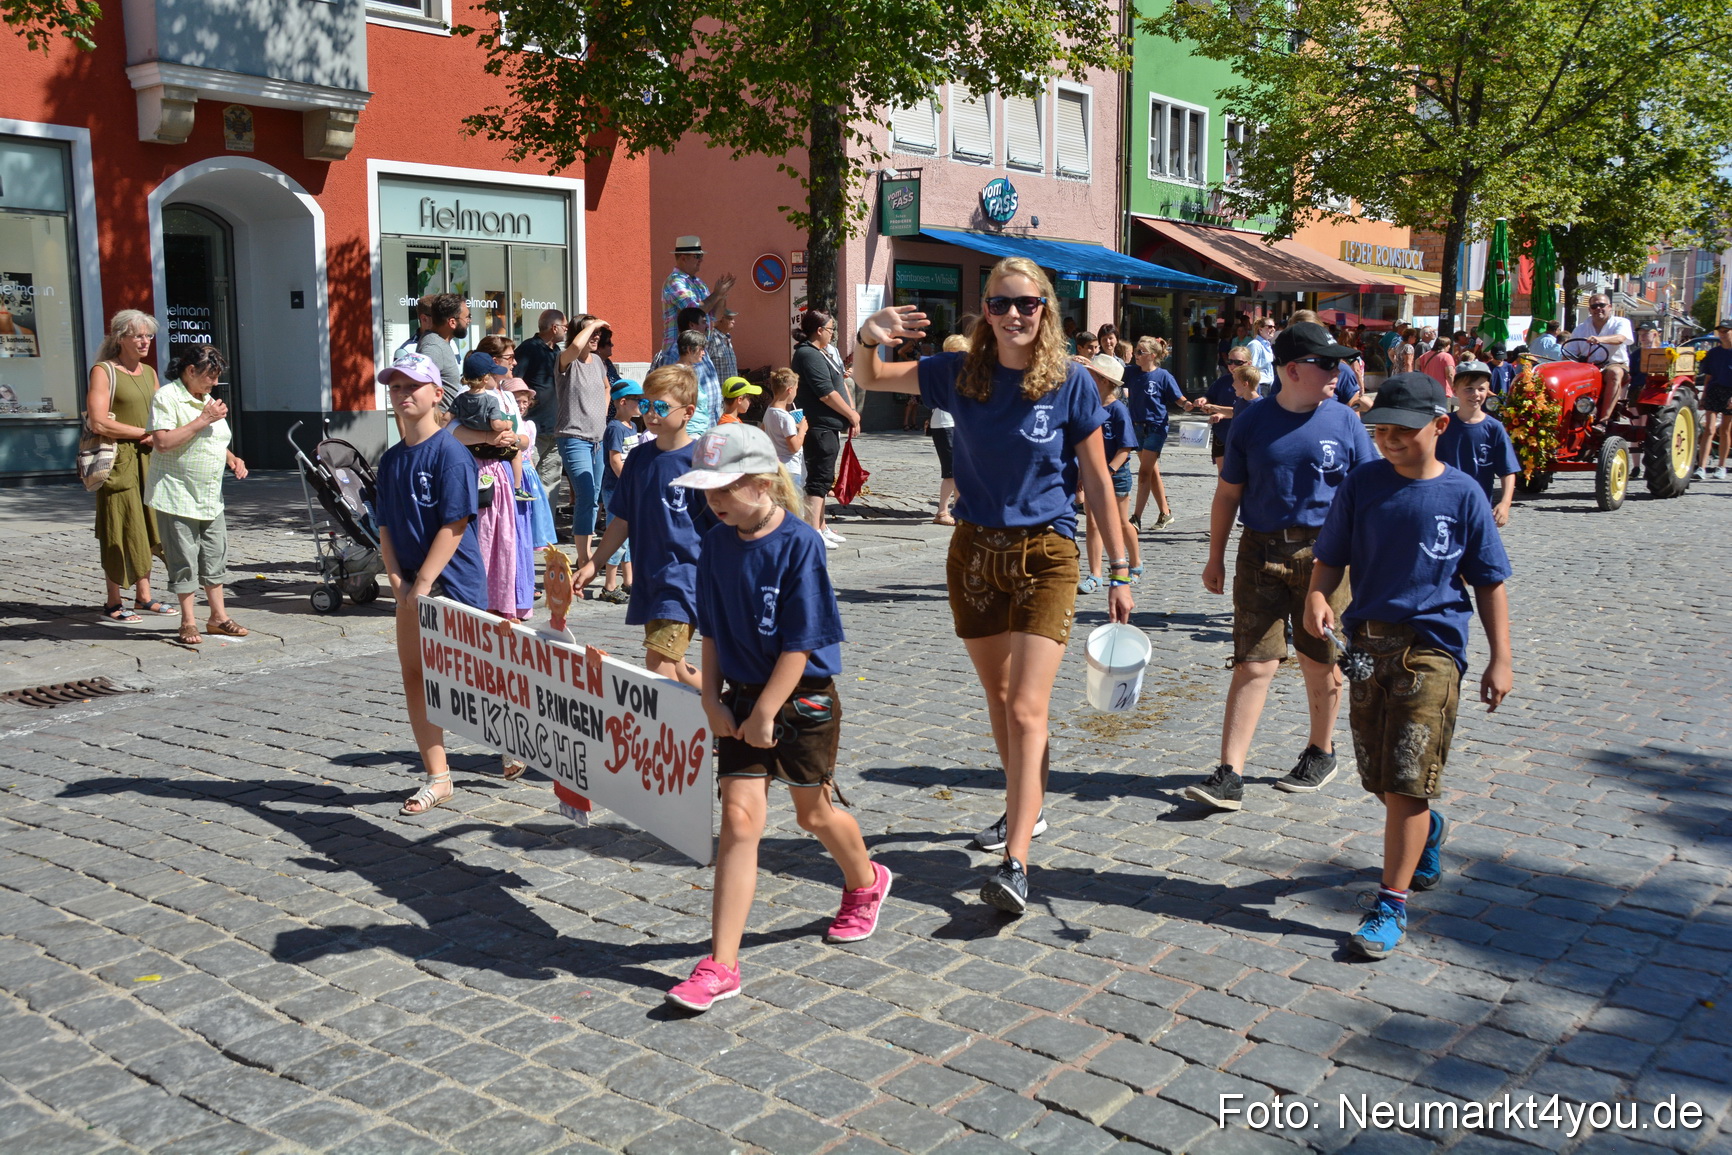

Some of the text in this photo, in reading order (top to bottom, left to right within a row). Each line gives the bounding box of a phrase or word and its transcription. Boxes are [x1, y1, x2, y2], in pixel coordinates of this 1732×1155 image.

[887, 190, 902, 201] vom
[892, 191, 914, 209] FASS
[982, 183, 1002, 200] vom
[988, 192, 1018, 217] FASS
[419, 196, 532, 238] fielmann
[1345, 240, 1372, 265] LEDER
[0, 282, 55, 297] ielmann
[896, 270, 958, 288] Spirituosen Whisky
[466, 296, 498, 309] elmann
[520, 297, 557, 310] fielmann
[418, 602, 659, 721] WIR MINISTRANTEN VON
[422, 637, 531, 710] WOFFENBACH
[535, 684, 604, 743] BRINGEN
[425, 679, 589, 791] IN DIE KIRCHE
